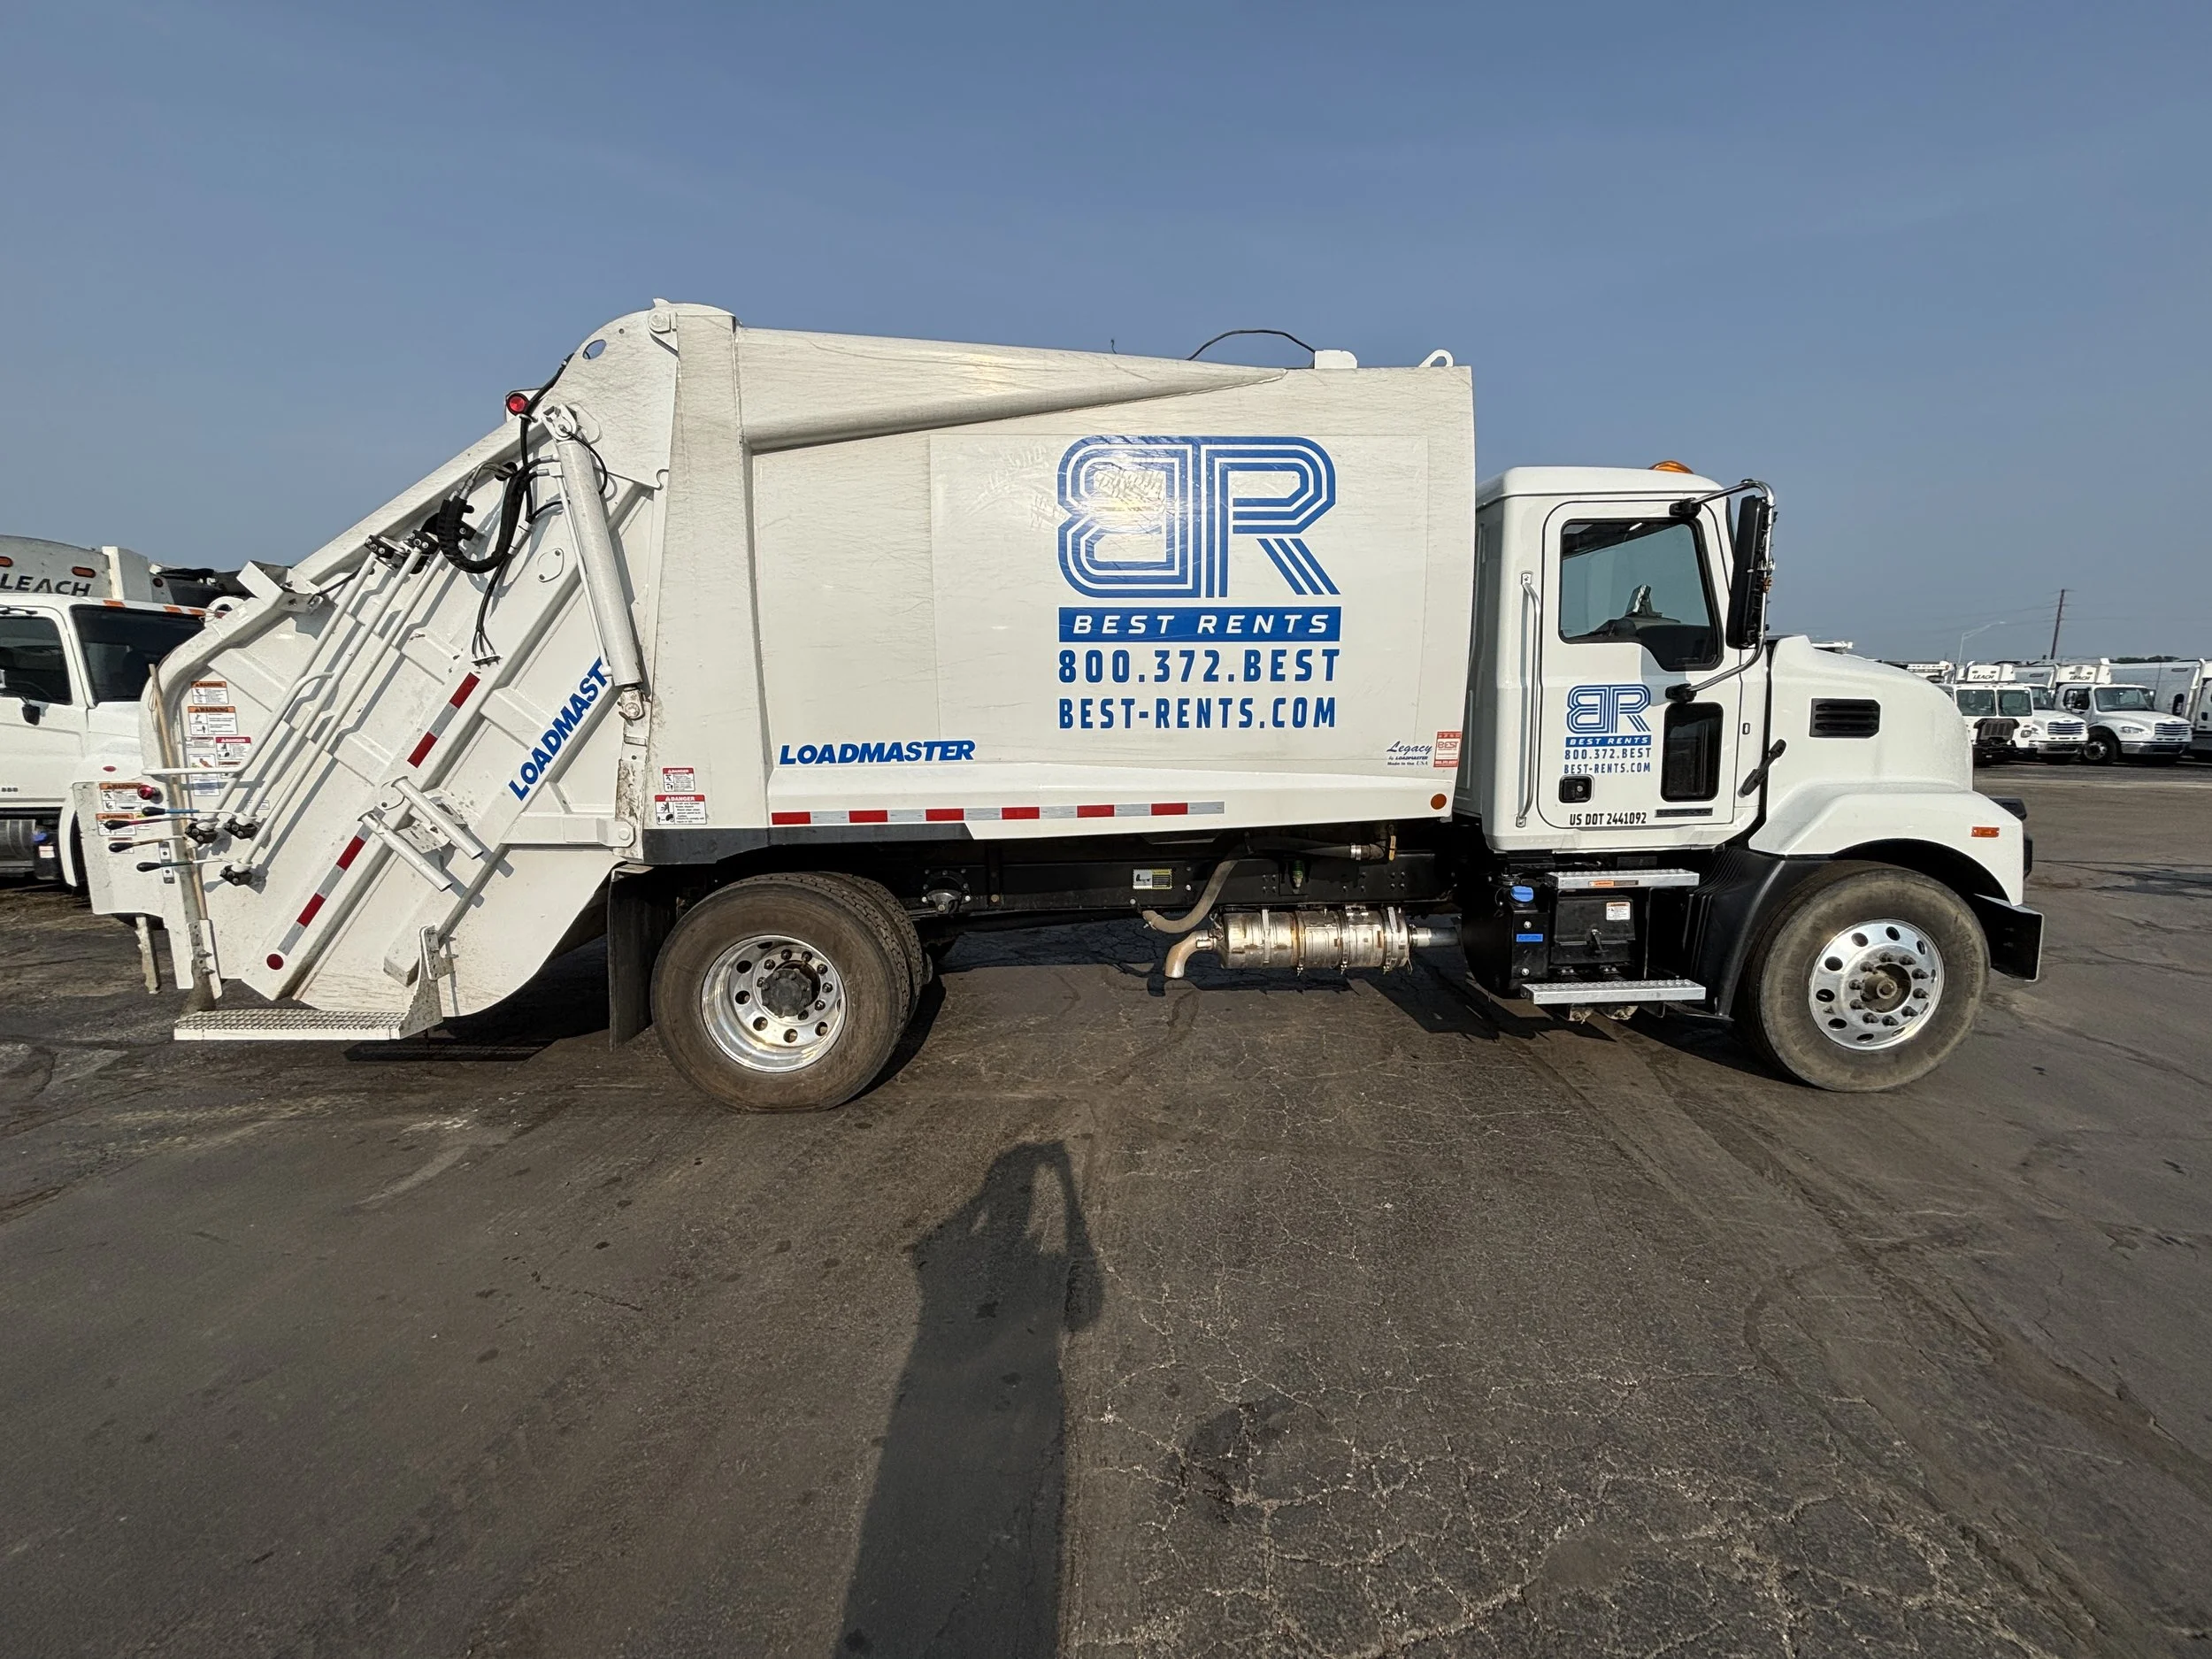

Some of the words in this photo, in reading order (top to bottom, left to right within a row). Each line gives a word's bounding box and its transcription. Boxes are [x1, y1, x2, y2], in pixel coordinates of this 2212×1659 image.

[0, 573, 91, 596] LEACH
[1072, 615, 1175, 634] BEST
[1196, 614, 1329, 634] RENTS
[1058, 649, 1340, 683] 800.372.BEST
[1058, 697, 1336, 729] BEST-RENTS.COM
[508, 656, 608, 802] LOADMAST
[1386, 741, 1432, 756] Legacy
[1607, 736, 1648, 745] RENTS
[780, 740, 976, 765] LOADMASTER
[1564, 748, 1652, 760] 800.372.BEST
[1563, 762, 1651, 774] BEST-RENTS.COM
[1570, 813, 1582, 826] US
[1585, 812, 1605, 825] DOT
[1606, 811, 1647, 825] 2441092
